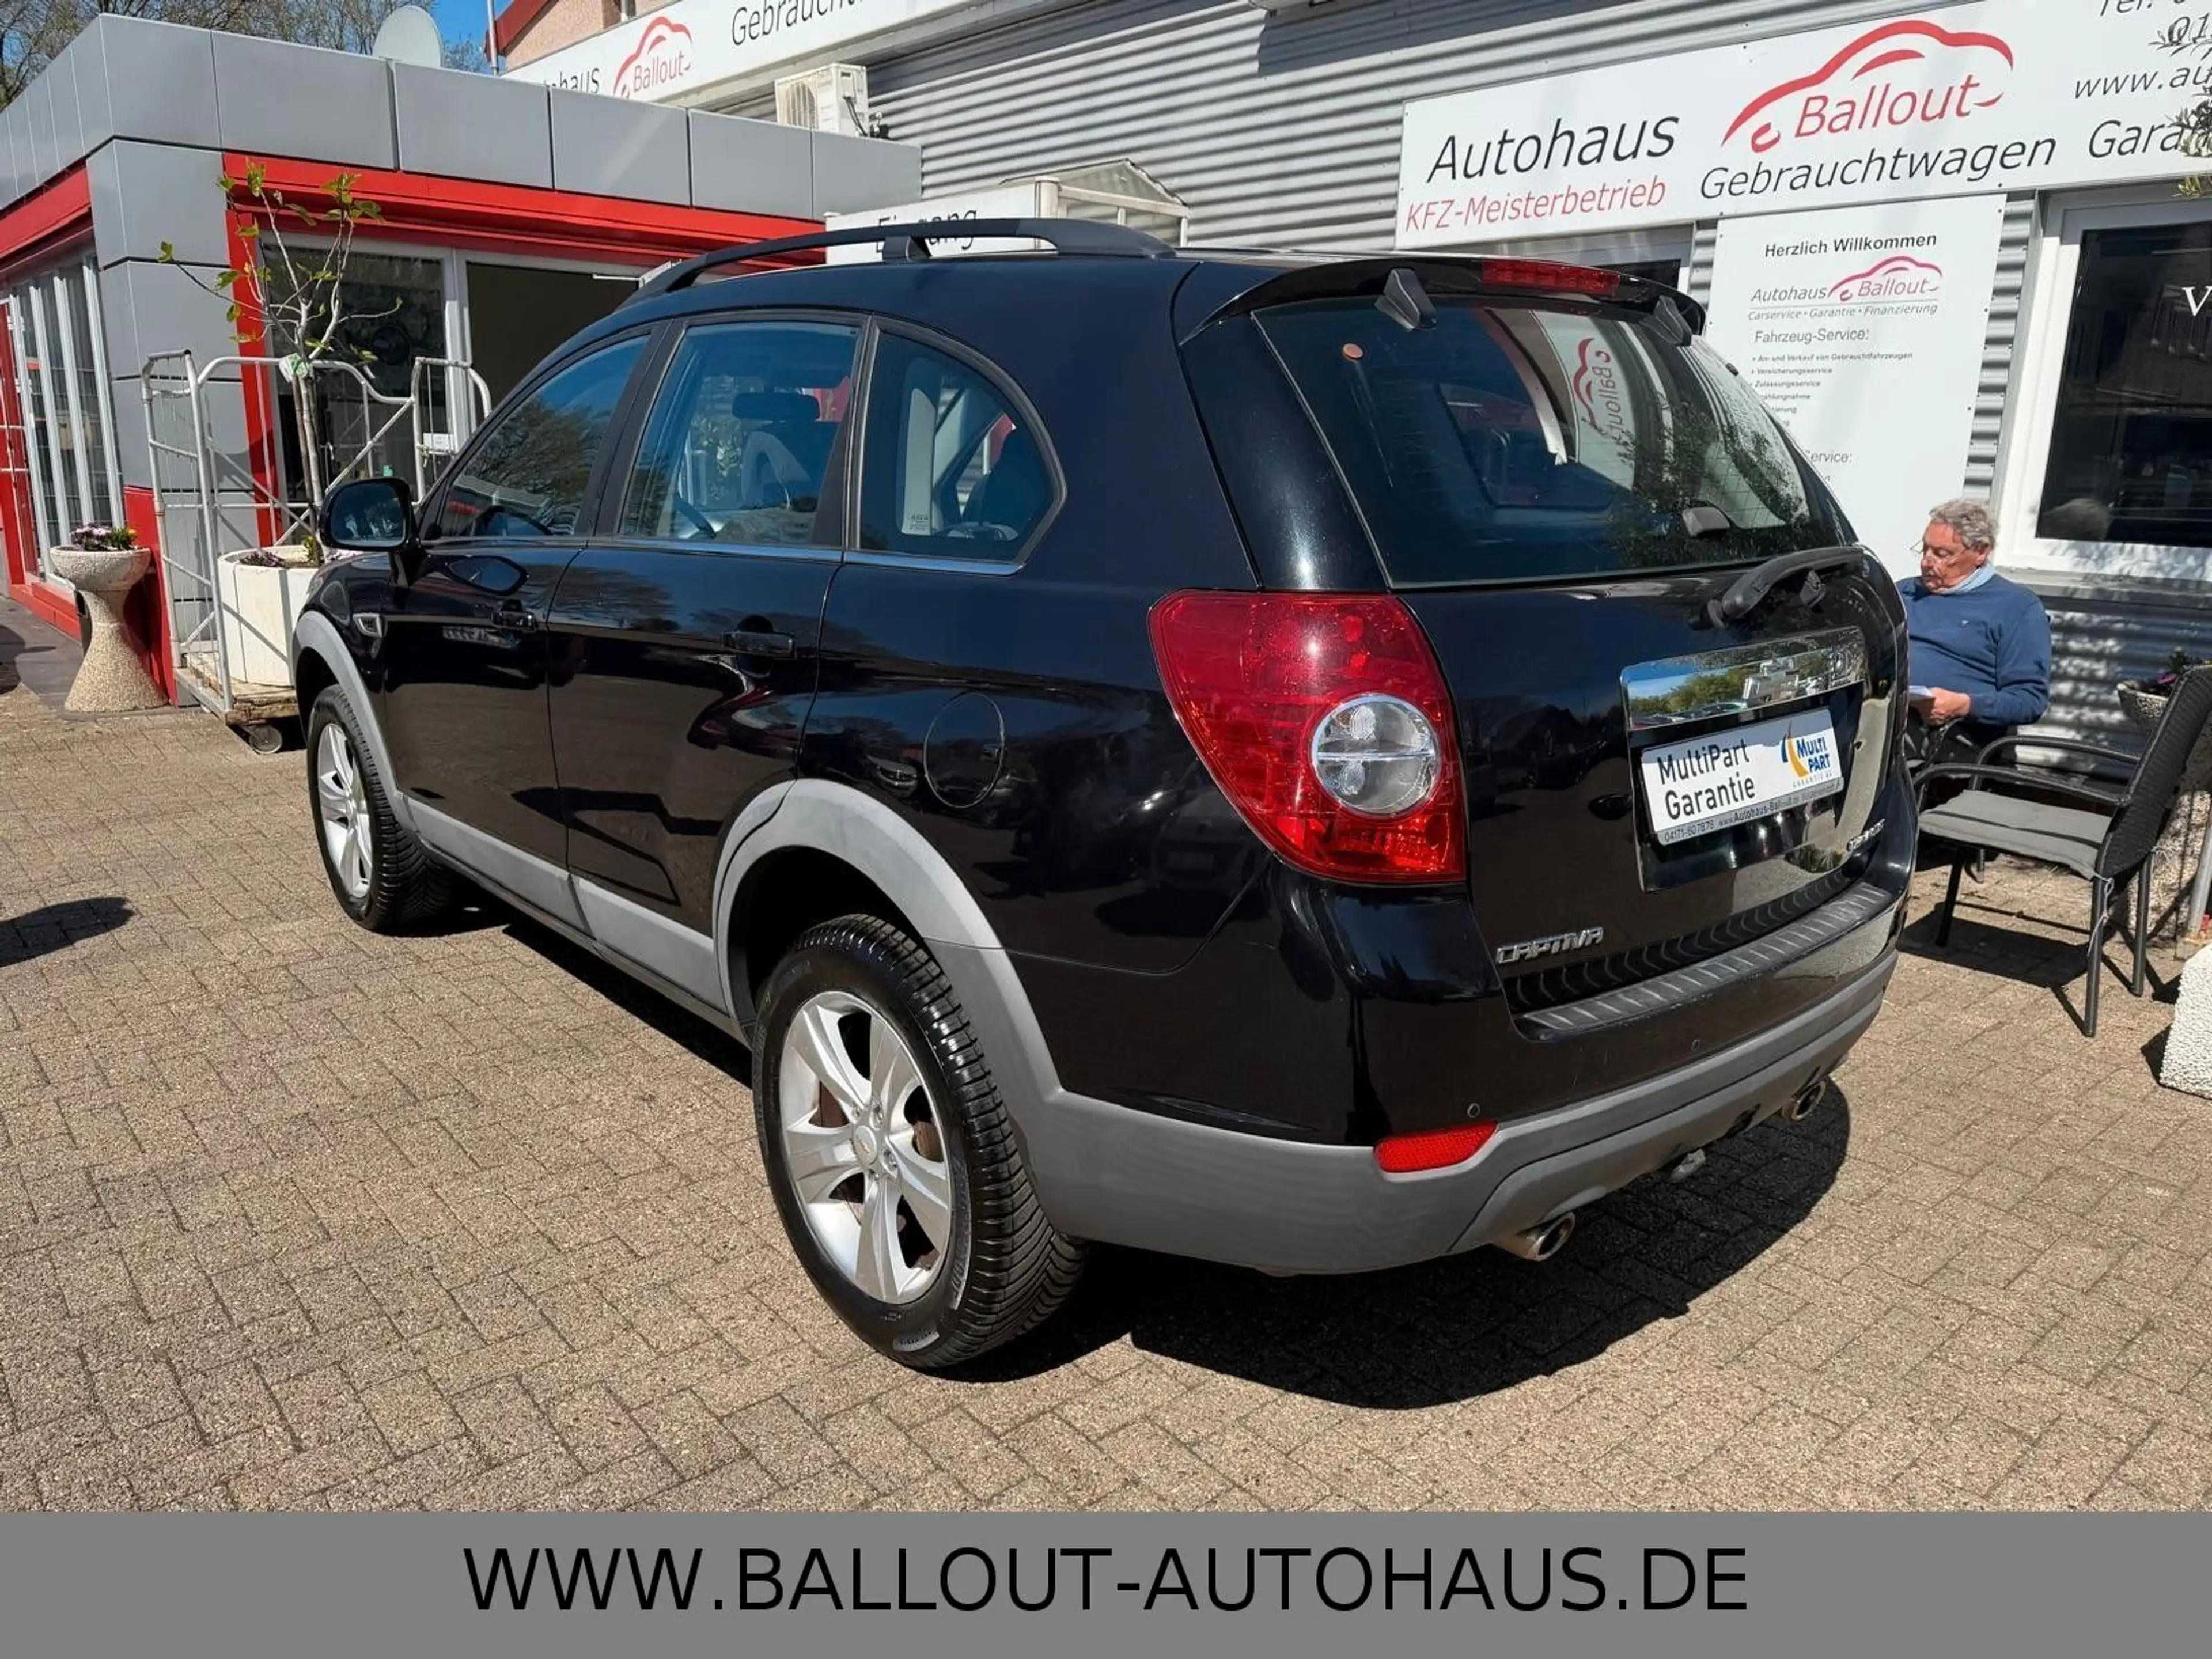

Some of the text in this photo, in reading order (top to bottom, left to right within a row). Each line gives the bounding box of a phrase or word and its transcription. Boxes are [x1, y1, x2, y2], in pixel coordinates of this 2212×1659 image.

[634, 50, 684, 92] Ballout
[1426, 75, 1980, 183] Autohaus Ballout
[1406, 137, 2057, 232] KFZ-Meisterbetrieb Gebrauchtwagen
[1764, 234, 1937, 257] Herzlich Willkommen
[1750, 277, 1930, 302] Autohaus Ballout
[1748, 303, 1938, 321] Carservice Garantie Finanzierung
[1755, 328, 1870, 345] Fahrzeug-Service:
[1657, 738, 1750, 785] MultiPart
[1795, 736, 1828, 759] MULTI
[1808, 753, 1831, 773] PART
[1665, 771, 1756, 820] Garantie
[1497, 927, 1604, 964] CAPTIVA
